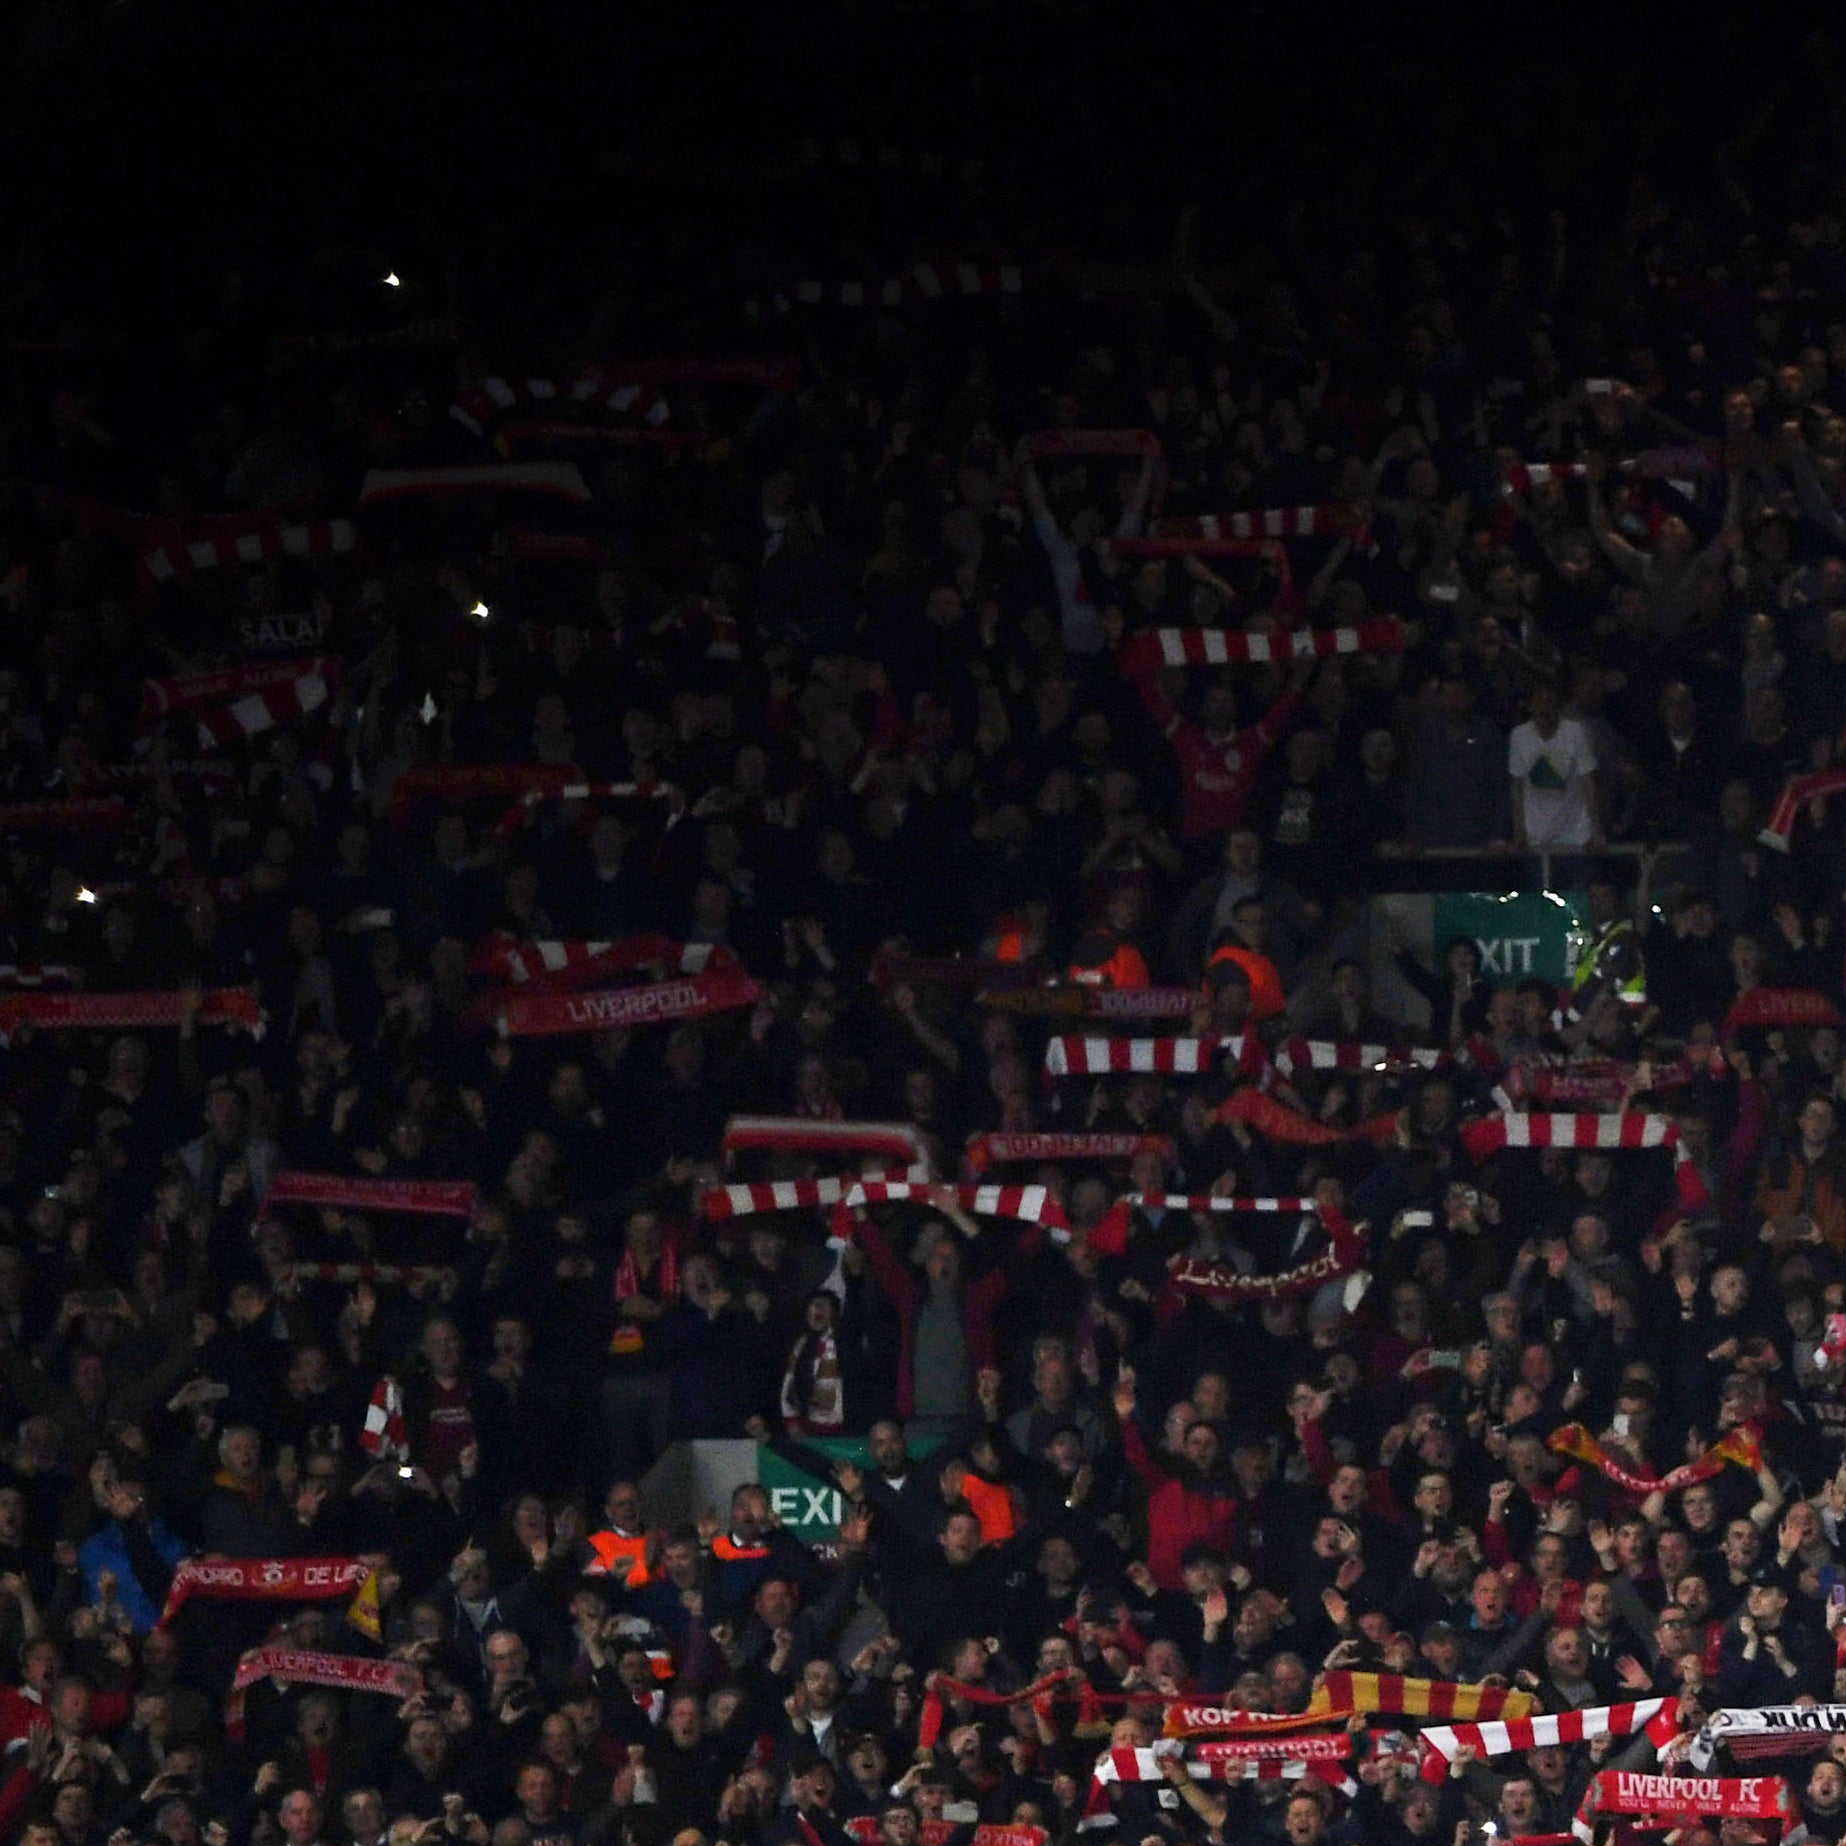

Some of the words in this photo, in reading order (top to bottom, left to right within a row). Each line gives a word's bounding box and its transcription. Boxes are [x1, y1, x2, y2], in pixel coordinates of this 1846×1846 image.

[1476, 937, 1540, 973] XIT
[566, 986, 708, 1022] LIVERPOOL
[771, 1487, 843, 1526] EXI
[1617, 1774, 1723, 1802] LIVERPOOL
[1739, 1778, 1763, 1802] FC
